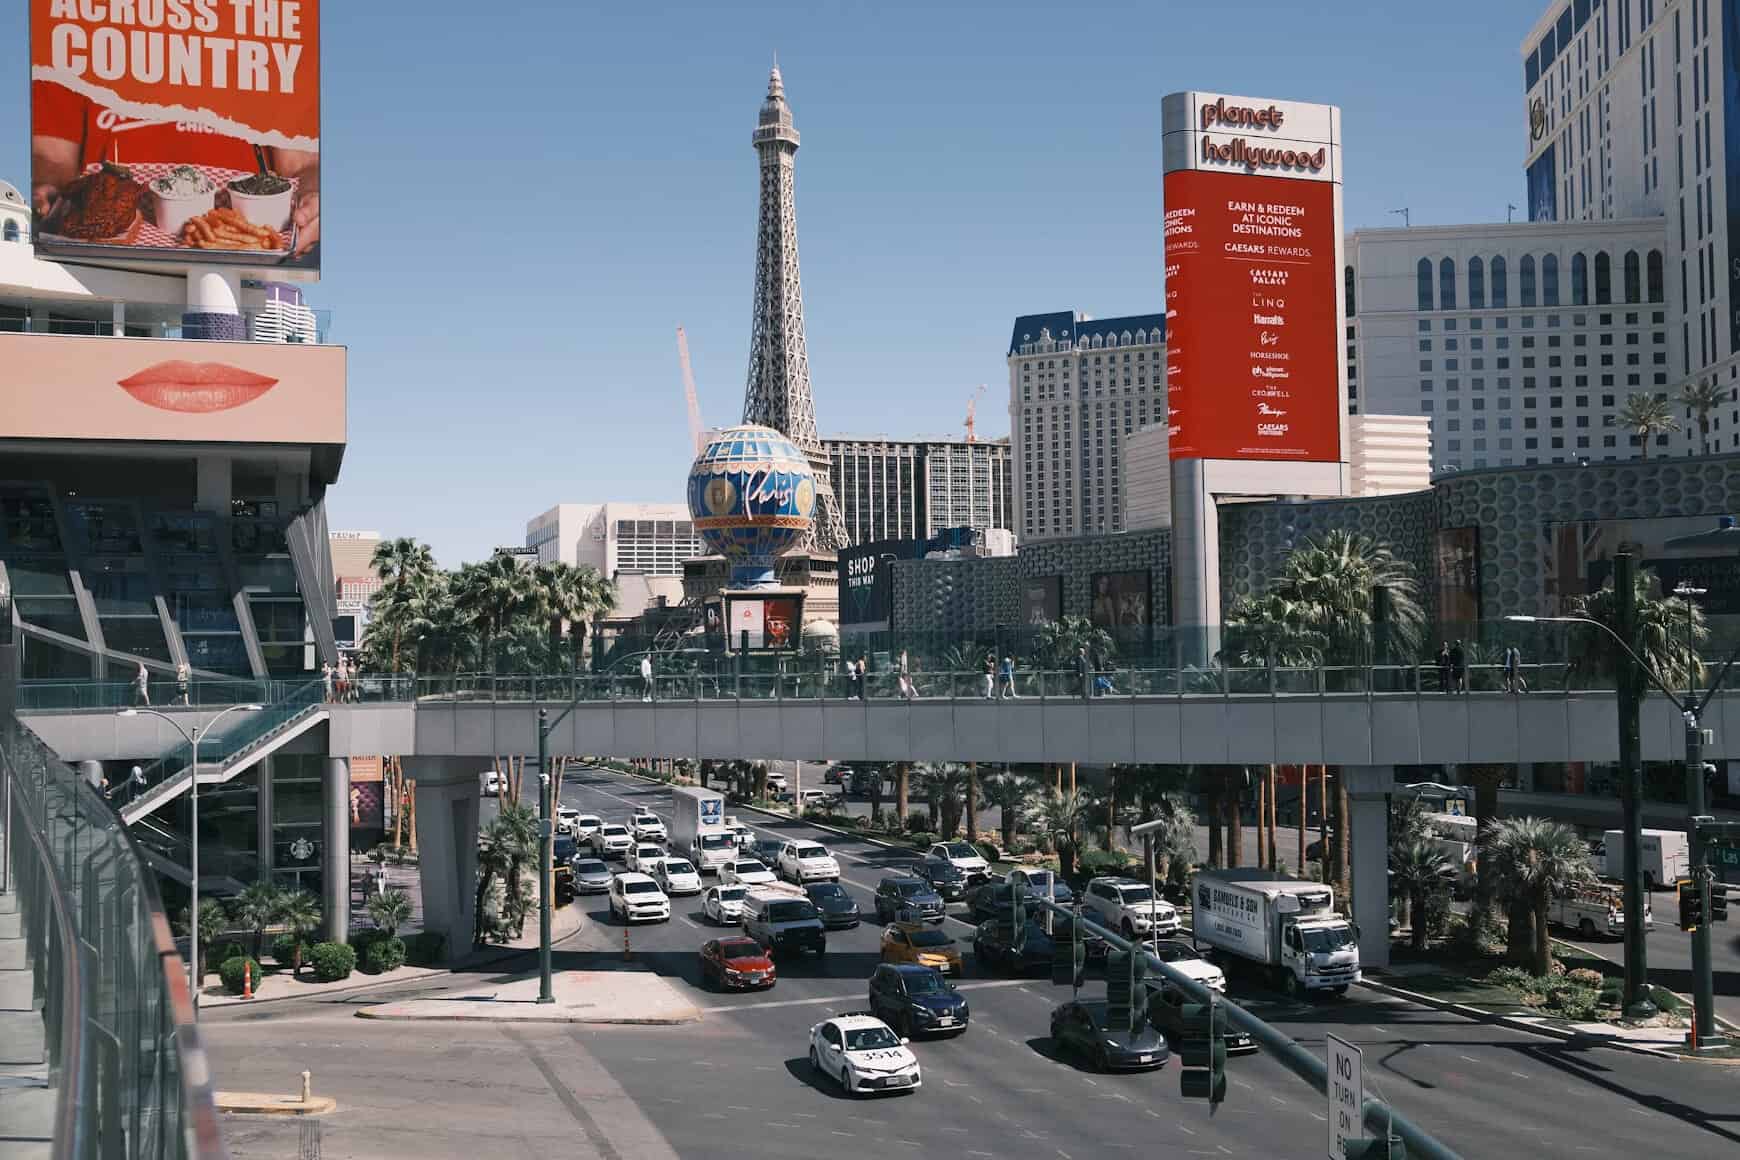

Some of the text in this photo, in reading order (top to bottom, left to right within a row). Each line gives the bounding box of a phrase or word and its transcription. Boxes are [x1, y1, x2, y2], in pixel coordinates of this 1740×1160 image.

[50, 0, 301, 39] ACROSS THE
[51, 23, 303, 94] COUNTRY
[1202, 97, 1284, 130] planet
[1201, 135, 1327, 172] hollywood
[1228, 200, 1305, 217] EARN & REDEEM
[1242, 213, 1292, 227] AT ICONIC
[1232, 223, 1303, 238] DESTINATIONS
[1224, 242, 1265, 255] CAESARS
[1250, 269, 1289, 278] CAESARS
[1252, 298, 1285, 308] LINQ
[1257, 423, 1289, 432] CAESARS
[745, 463, 794, 521] Paris
[848, 555, 875, 576] SHOP
[848, 575, 874, 588] THIS WAY
[1336, 1053, 1352, 1080] NO
[1334, 1081, 1356, 1109] TURN
[1339, 1110, 1351, 1129] ON
